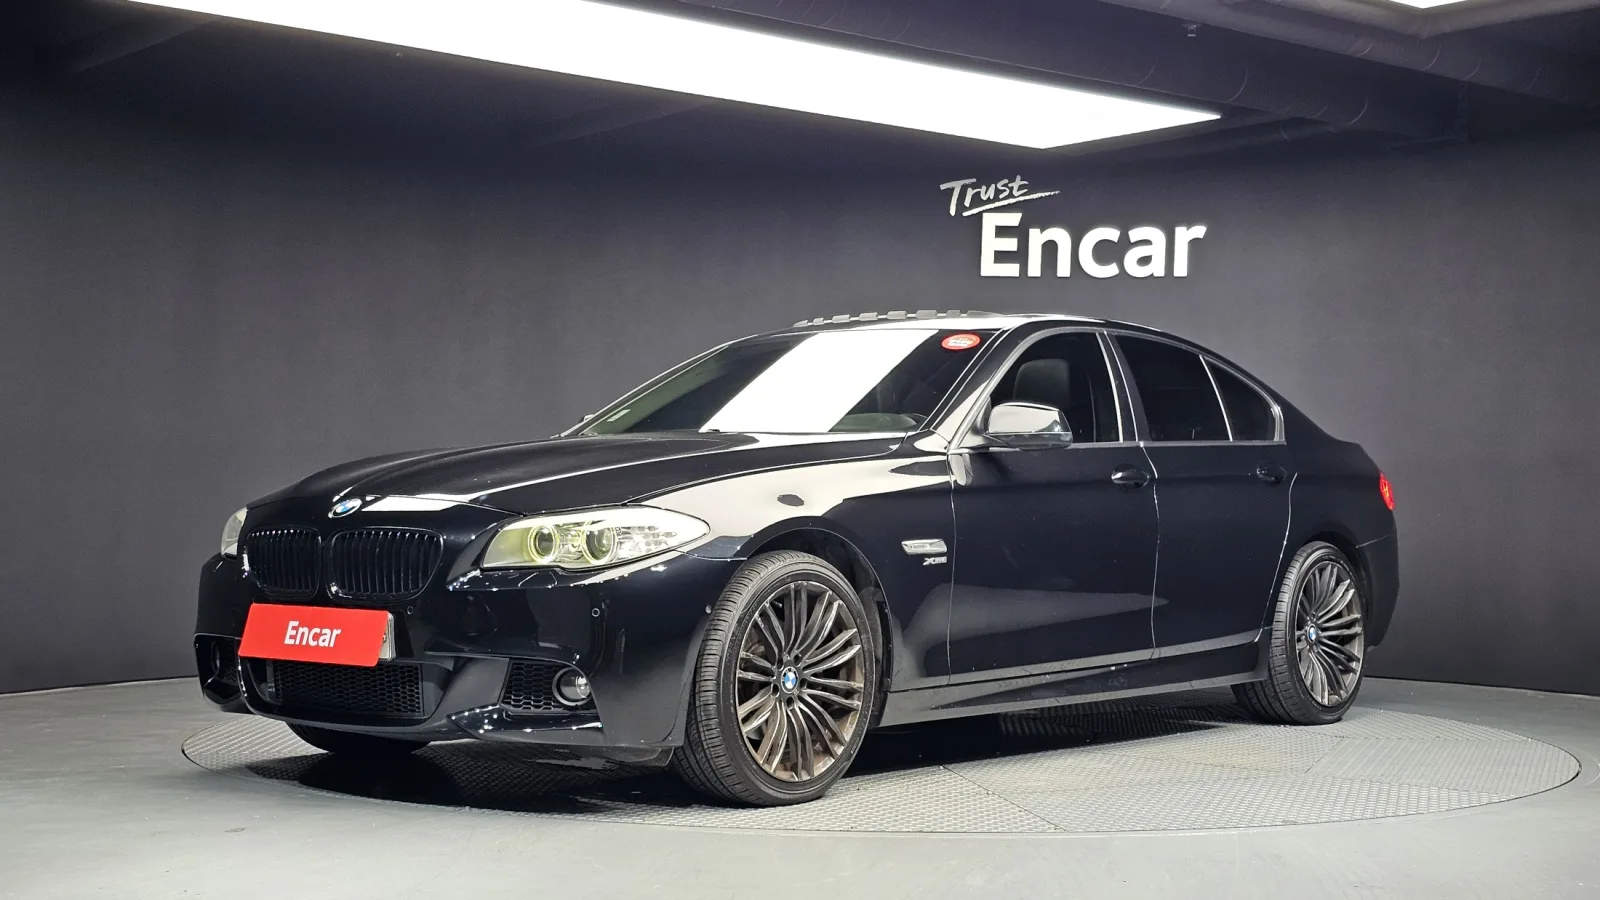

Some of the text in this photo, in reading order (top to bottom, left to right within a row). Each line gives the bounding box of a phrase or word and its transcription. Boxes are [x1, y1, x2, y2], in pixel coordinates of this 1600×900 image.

[940, 175, 1029, 217] Trust
[980, 212, 1208, 279] Encar
[284, 620, 342, 648] Encar
